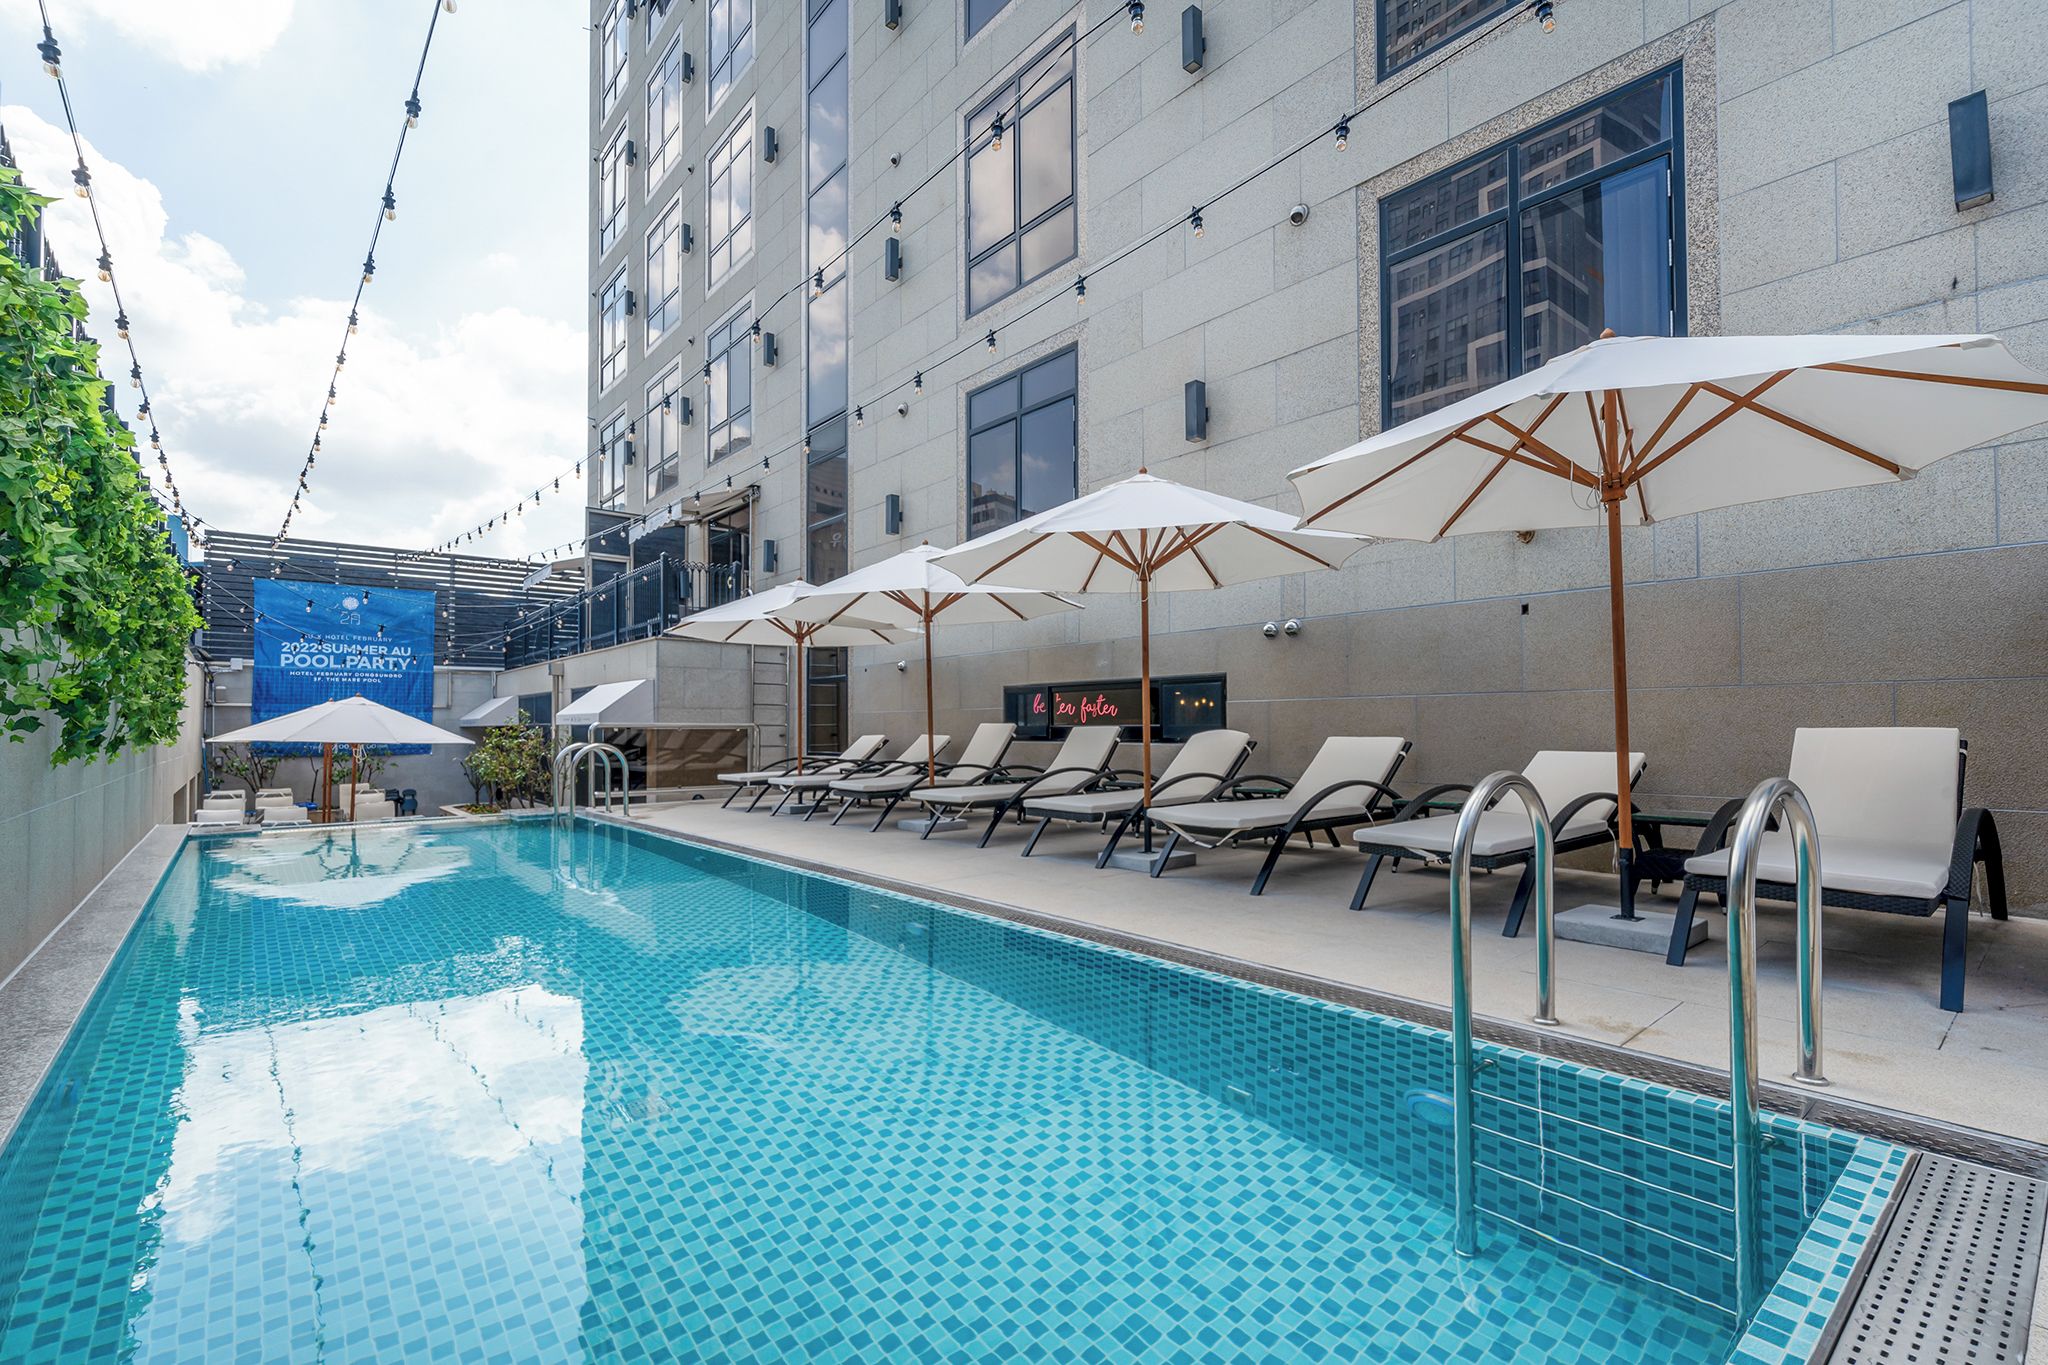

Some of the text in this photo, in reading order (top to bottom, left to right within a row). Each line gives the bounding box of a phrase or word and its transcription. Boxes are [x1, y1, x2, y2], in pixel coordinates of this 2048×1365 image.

[353, 635, 393, 643] FEBRUARY
[281, 642, 411, 657] 2022 SUMMER AU
[280, 653, 411, 671] POOL PARTY
[1080, 694, 1118, 724] faster
